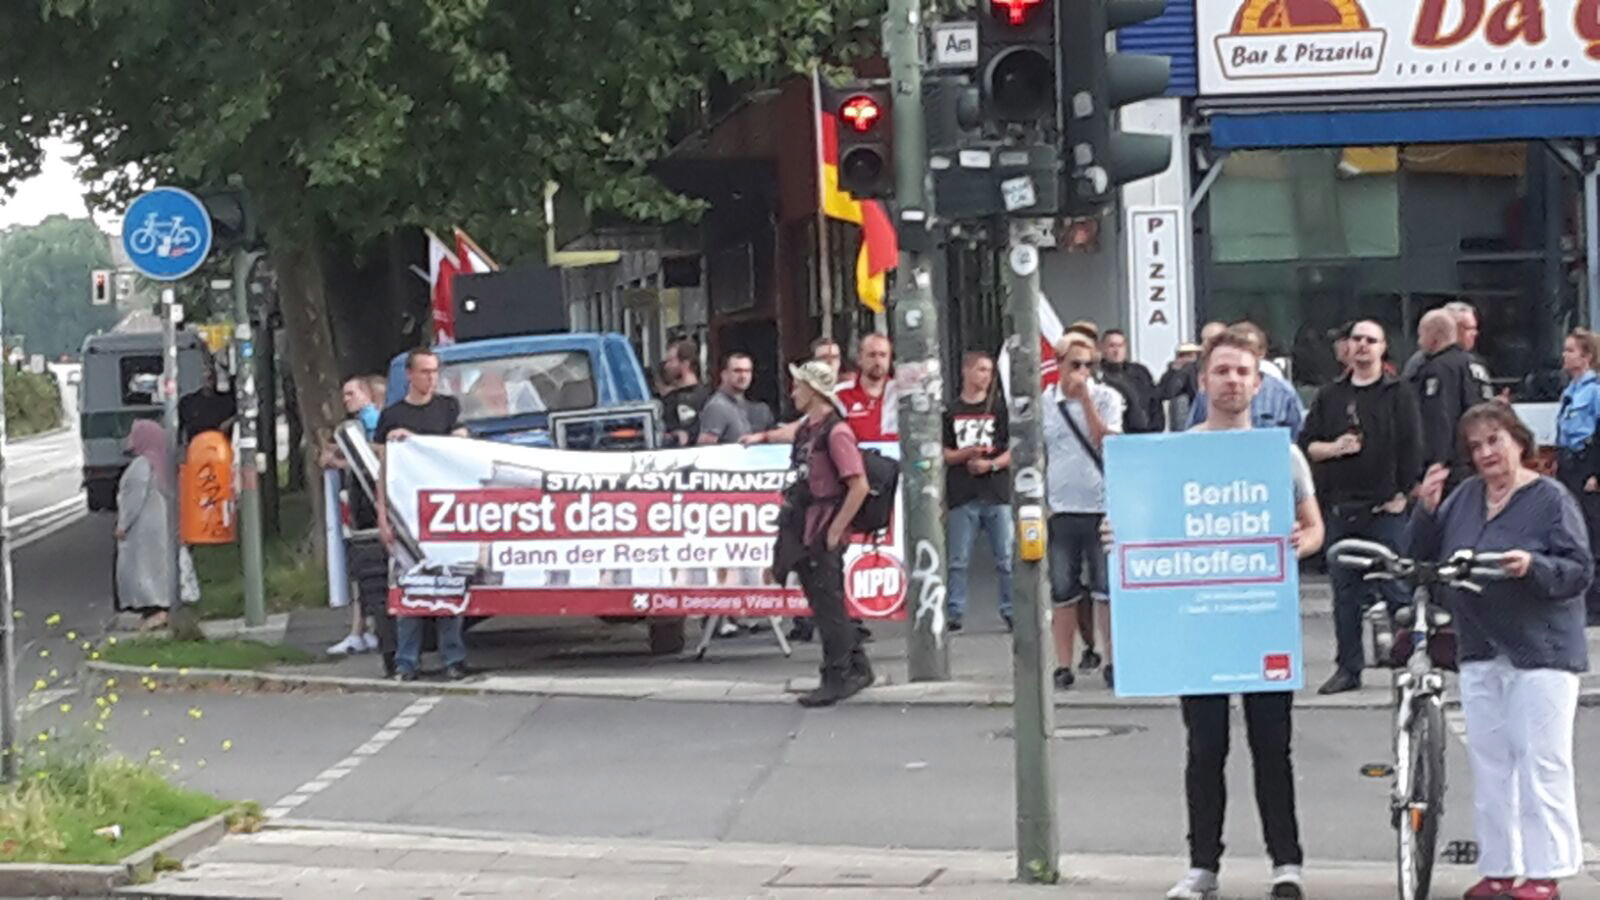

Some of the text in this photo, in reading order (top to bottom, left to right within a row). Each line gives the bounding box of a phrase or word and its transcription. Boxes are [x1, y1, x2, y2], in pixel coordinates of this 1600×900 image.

[1412, 0, 1546, 49] Da
[1231, 41, 1374, 67] Bar & Pizzeria
[1147, 216, 1168, 326] PIZZA
[546, 472, 621, 491] STATT
[1183, 480, 1269, 506] Berlin
[429, 492, 780, 540] Zuerst das eigene
[1185, 511, 1271, 537] bleibt
[499, 542, 774, 565] dann der Rest der Wel
[1131, 552, 1276, 578] weltoffen.
[853, 567, 900, 599] NPD
